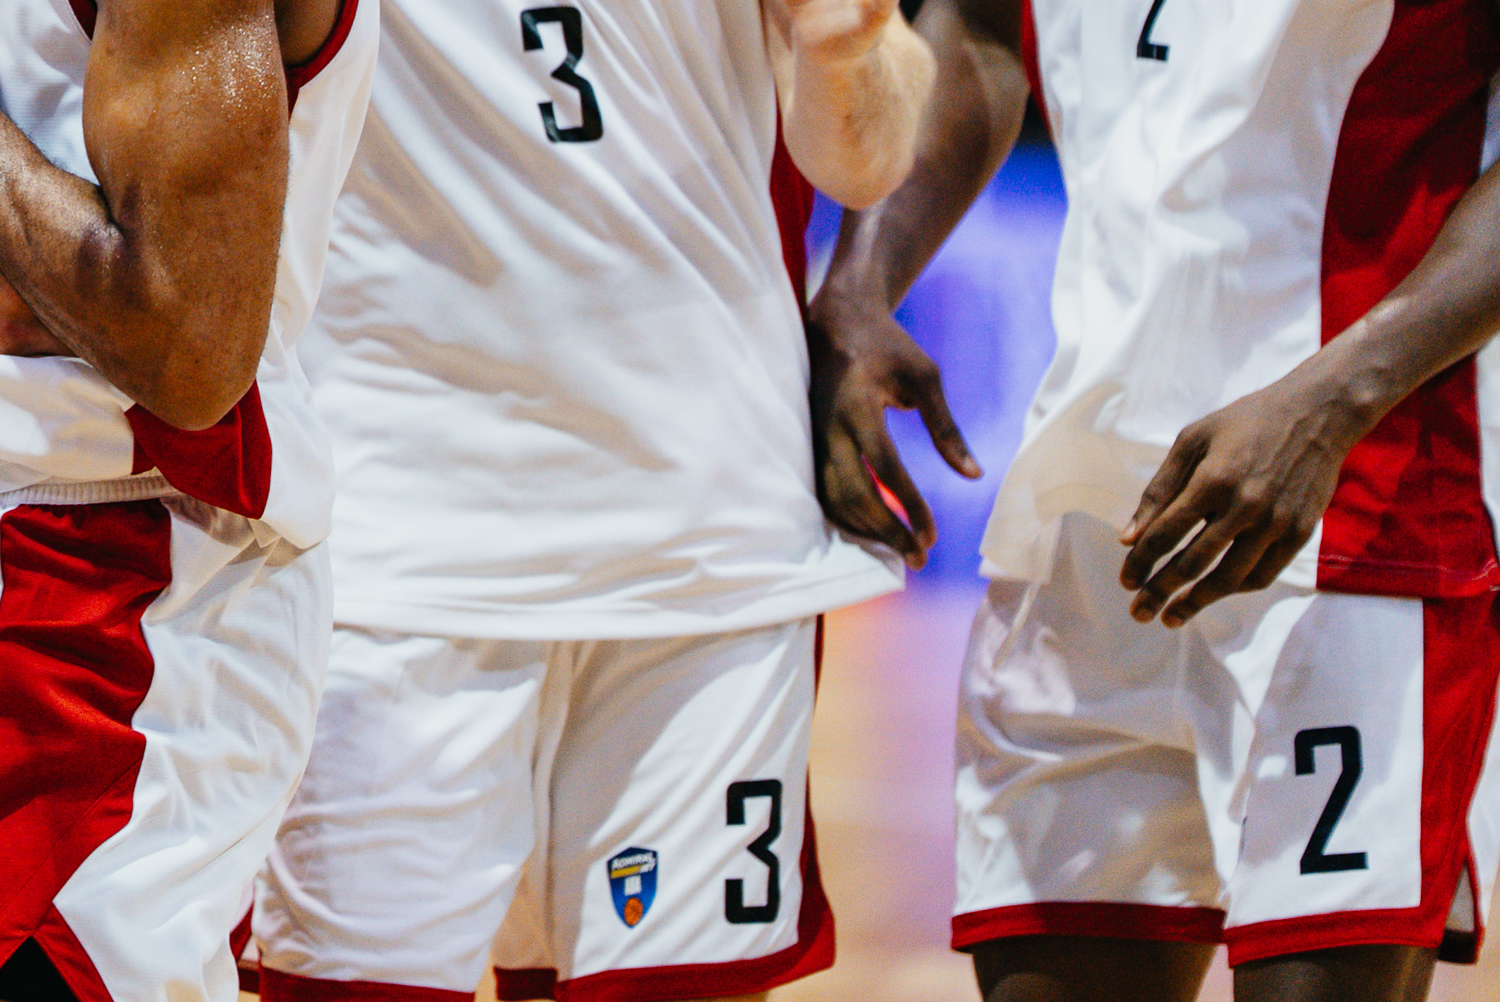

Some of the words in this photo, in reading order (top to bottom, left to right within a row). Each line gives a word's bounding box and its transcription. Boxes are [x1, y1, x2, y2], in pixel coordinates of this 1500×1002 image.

[520, 6, 604, 144] 3
[725, 778, 783, 925] 3
[1294, 725, 1369, 875] 2
